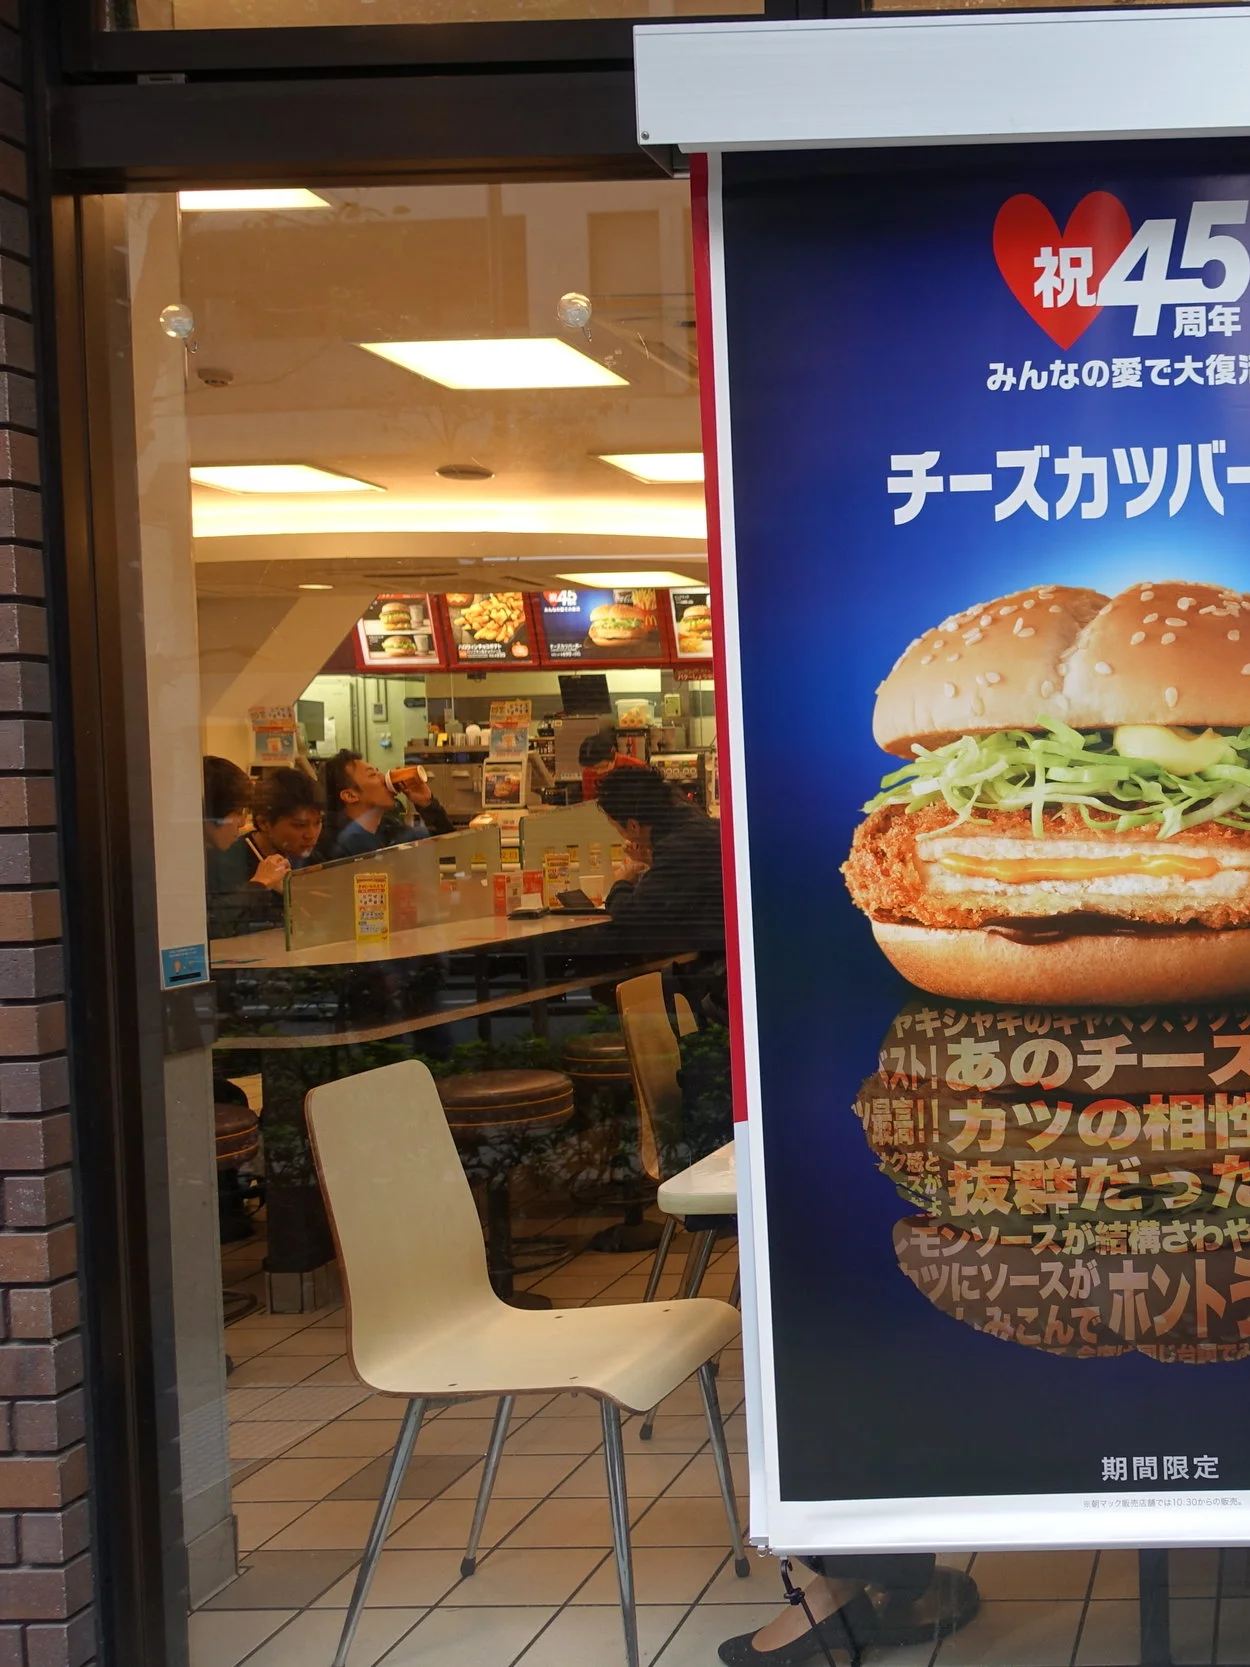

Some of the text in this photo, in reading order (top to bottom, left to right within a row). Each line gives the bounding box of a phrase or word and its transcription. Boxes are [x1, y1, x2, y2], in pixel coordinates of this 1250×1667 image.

[1033, 246, 1097, 308] 祝
[1173, 304, 1242, 339] 周年
[1101, 1455, 1220, 1481] 期間限定
